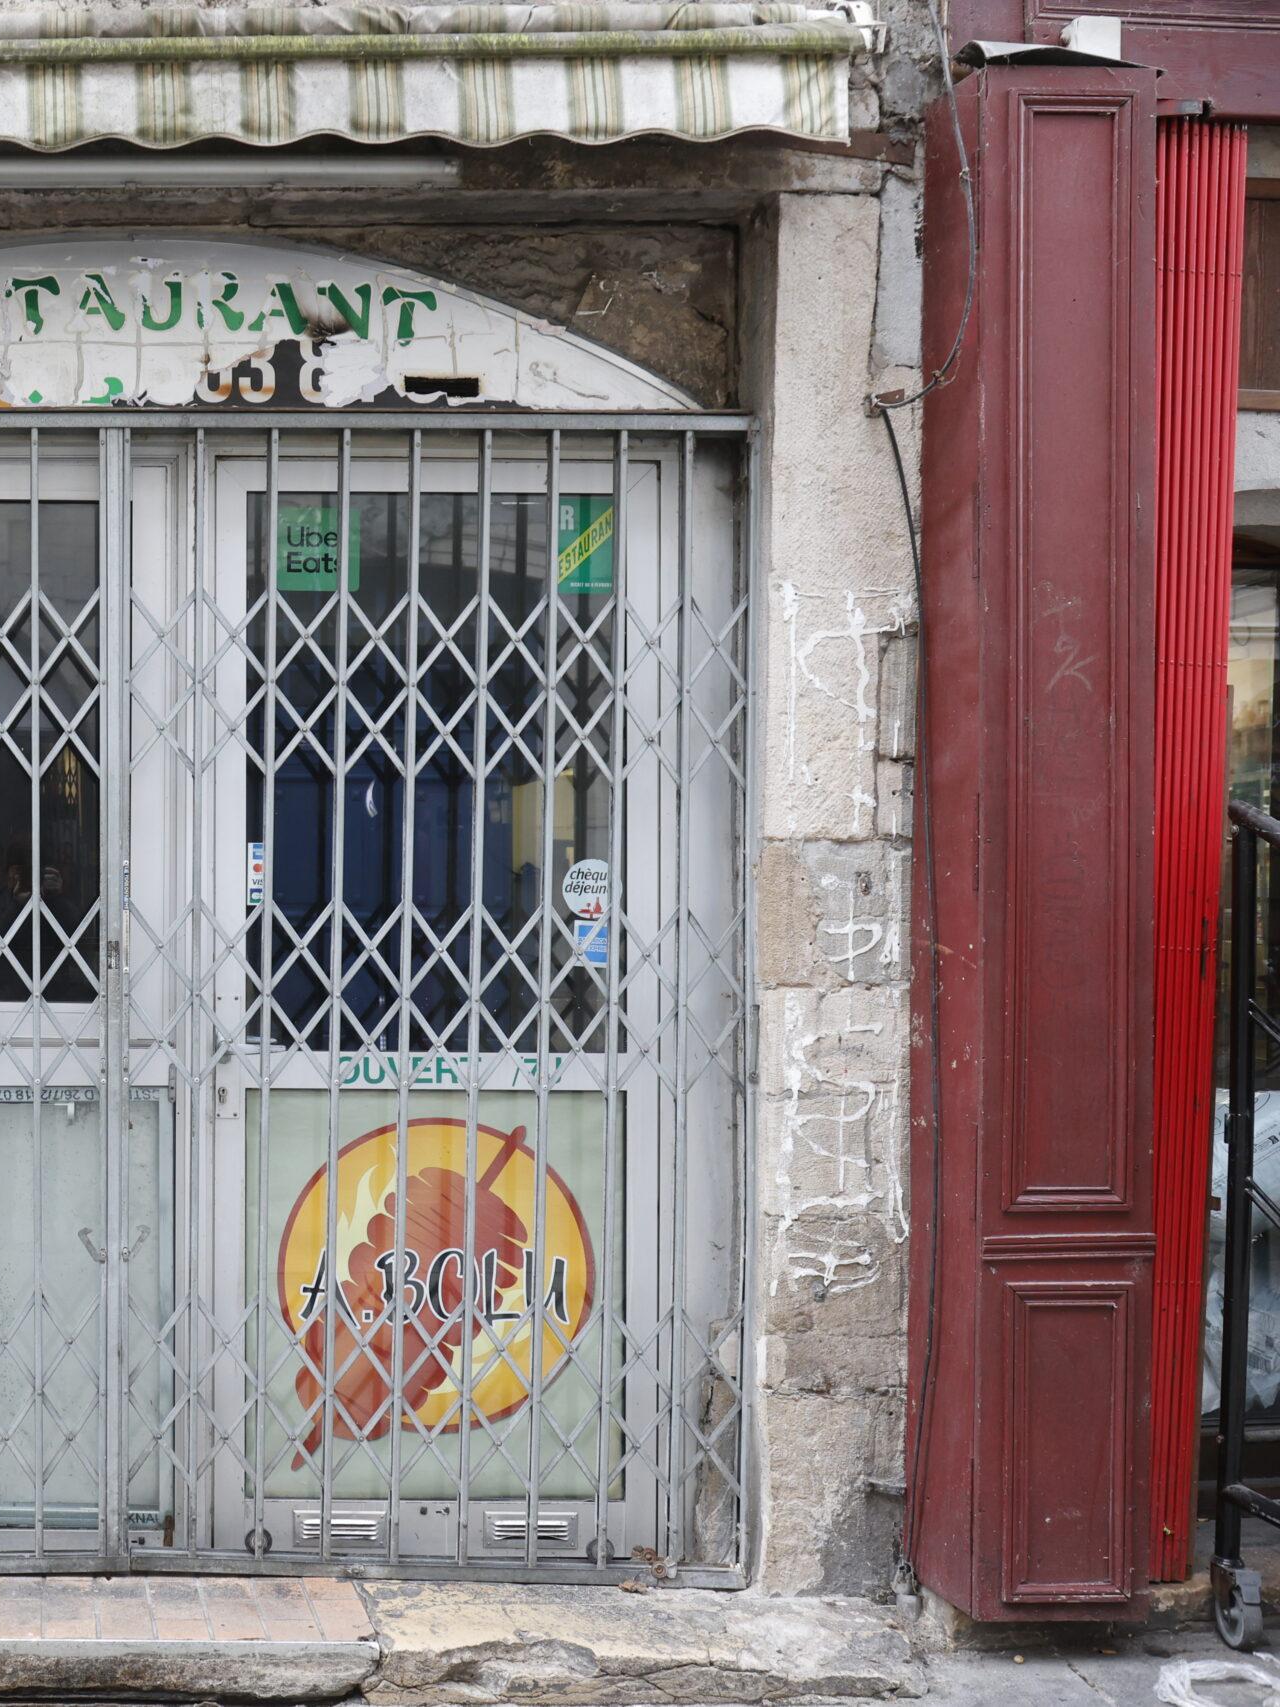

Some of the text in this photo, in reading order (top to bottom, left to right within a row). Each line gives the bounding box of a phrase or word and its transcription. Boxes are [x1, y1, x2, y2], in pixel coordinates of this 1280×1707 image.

[287, 526, 338, 548] Ube
[570, 868, 608, 884] chèqu
[565, 881, 608, 897] déjeun
